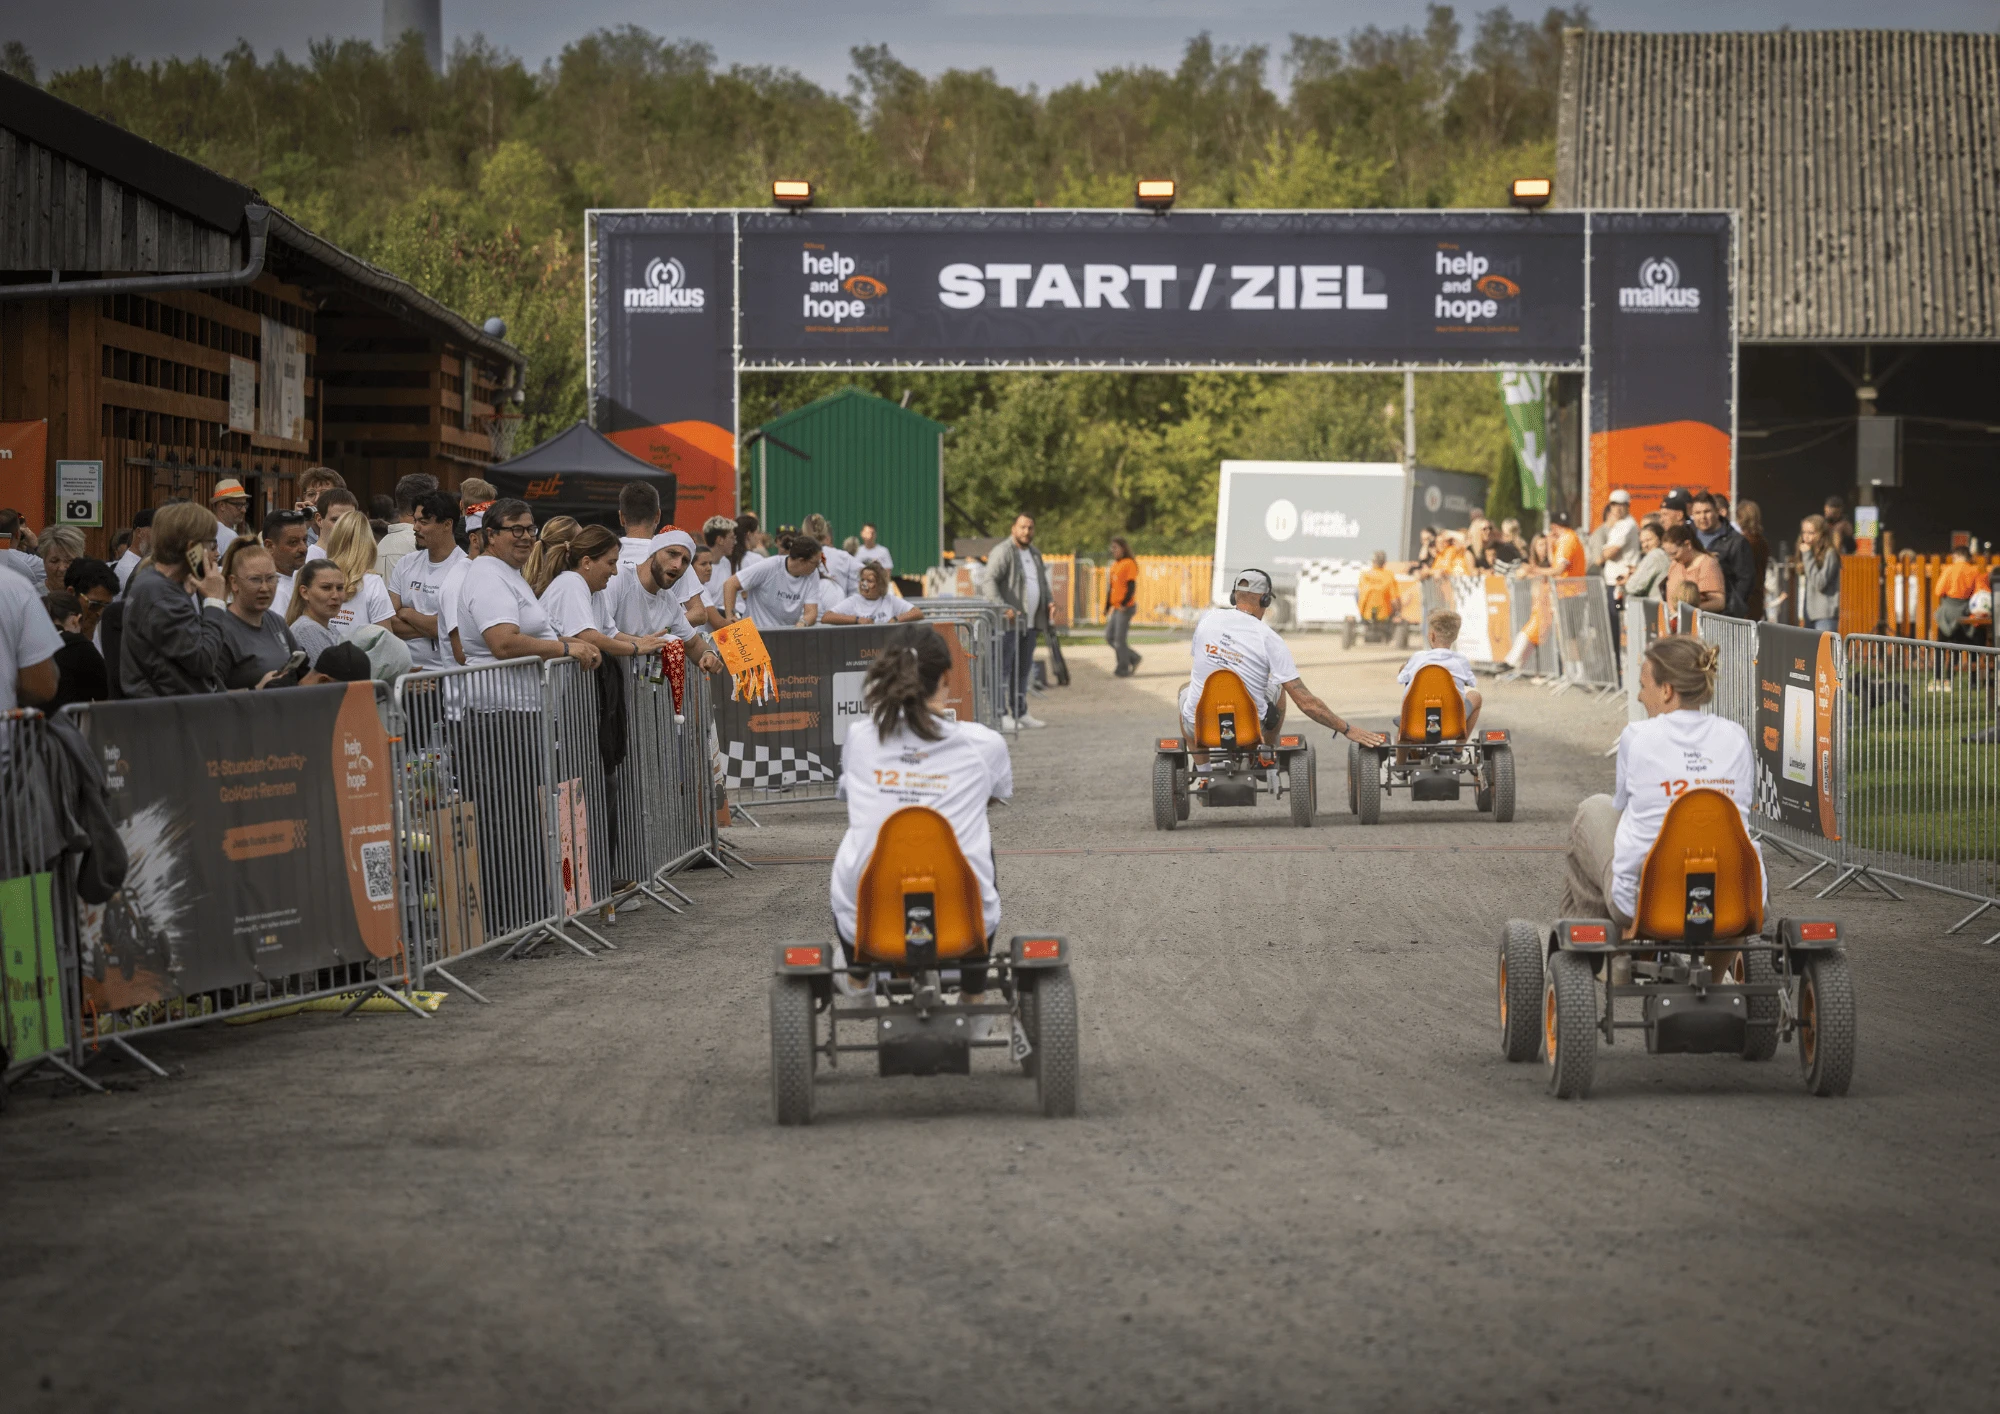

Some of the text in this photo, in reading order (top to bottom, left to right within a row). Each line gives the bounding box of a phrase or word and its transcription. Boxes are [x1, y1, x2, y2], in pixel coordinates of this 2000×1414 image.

[803, 251, 855, 280] help
[1435, 251, 1488, 280] help
[624, 283, 705, 307] malkus
[809, 278, 839, 293] and
[938, 263, 1388, 310] START / ZIEL
[1442, 278, 1472, 293] and
[1619, 284, 1700, 307] malkus
[803, 295, 865, 323] hope
[1435, 295, 1498, 323] hope
[730, 627, 754, 663] Aderhold
[1205, 643, 1218, 655] 12
[344, 739, 361, 757] help
[347, 773, 366, 791] hope
[874, 769, 900, 786] 12
[1660, 779, 1689, 797] 12
